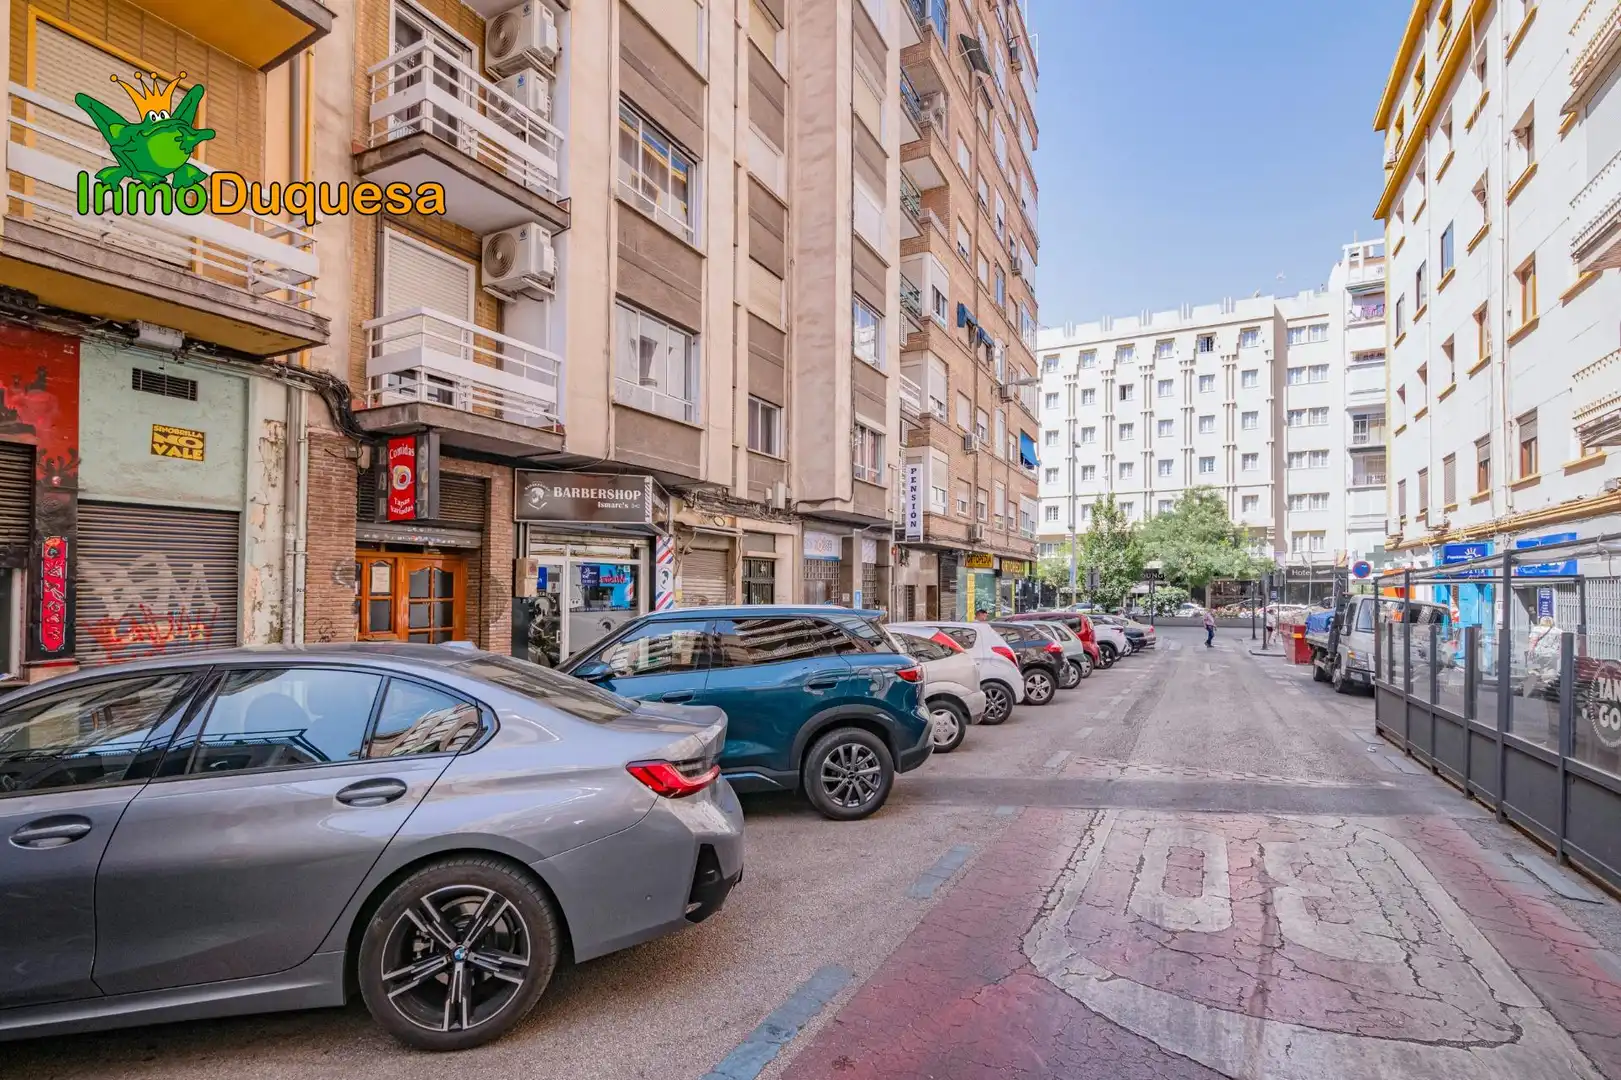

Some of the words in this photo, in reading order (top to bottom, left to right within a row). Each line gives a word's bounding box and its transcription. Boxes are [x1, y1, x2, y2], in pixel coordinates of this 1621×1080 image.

[153, 431, 204, 449] NO
[152, 443, 203, 460] VALE
[389, 443, 415, 459] Comidas
[553, 486, 642, 501] BARBERSHOP
[394, 497, 410, 507] Tapas
[967, 554, 992, 564] ORTOPEDIA
